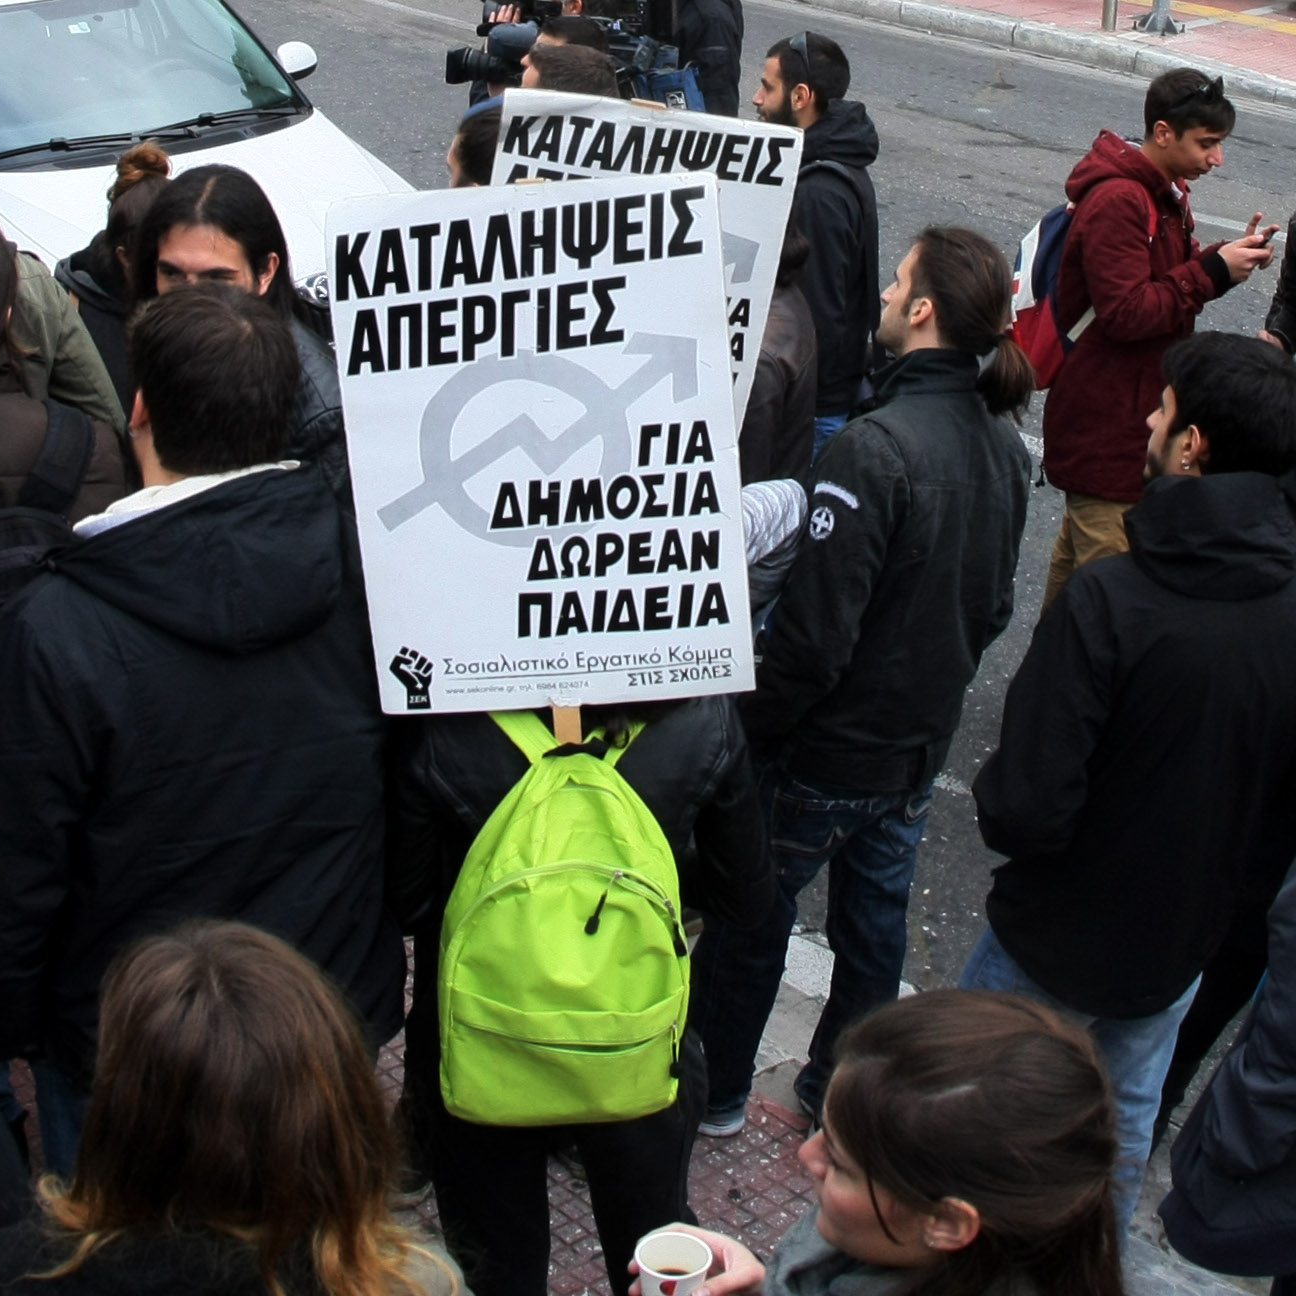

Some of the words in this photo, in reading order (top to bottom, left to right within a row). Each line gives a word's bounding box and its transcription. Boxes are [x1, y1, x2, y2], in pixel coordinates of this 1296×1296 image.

[503, 115, 796, 187] ΚΑΤΑΛΗΨΕΙΣ
[335, 185, 705, 302] ΚΑΤΑΛΗΨΕΙΣ
[347, 275, 627, 377] ΑΠΕΡΓΙΕΣ
[638, 420, 715, 467] ΓΙΑ
[490, 470, 721, 530] ΔΗΜΟΣΙΑ
[526, 528, 721, 582] ΔΩΡΕΑΝ
[517, 582, 730, 639] ΠΑΙΔΕΙΑ
[443, 652, 570, 675] Σοσιαλιστικό
[576, 647, 662, 672] Εργατικό
[668, 644, 732, 665] Κόμμα
[627, 670, 664, 687] ΣΤΙΣ
[669, 665, 732, 683] ΣΧΟΛΕΣ
